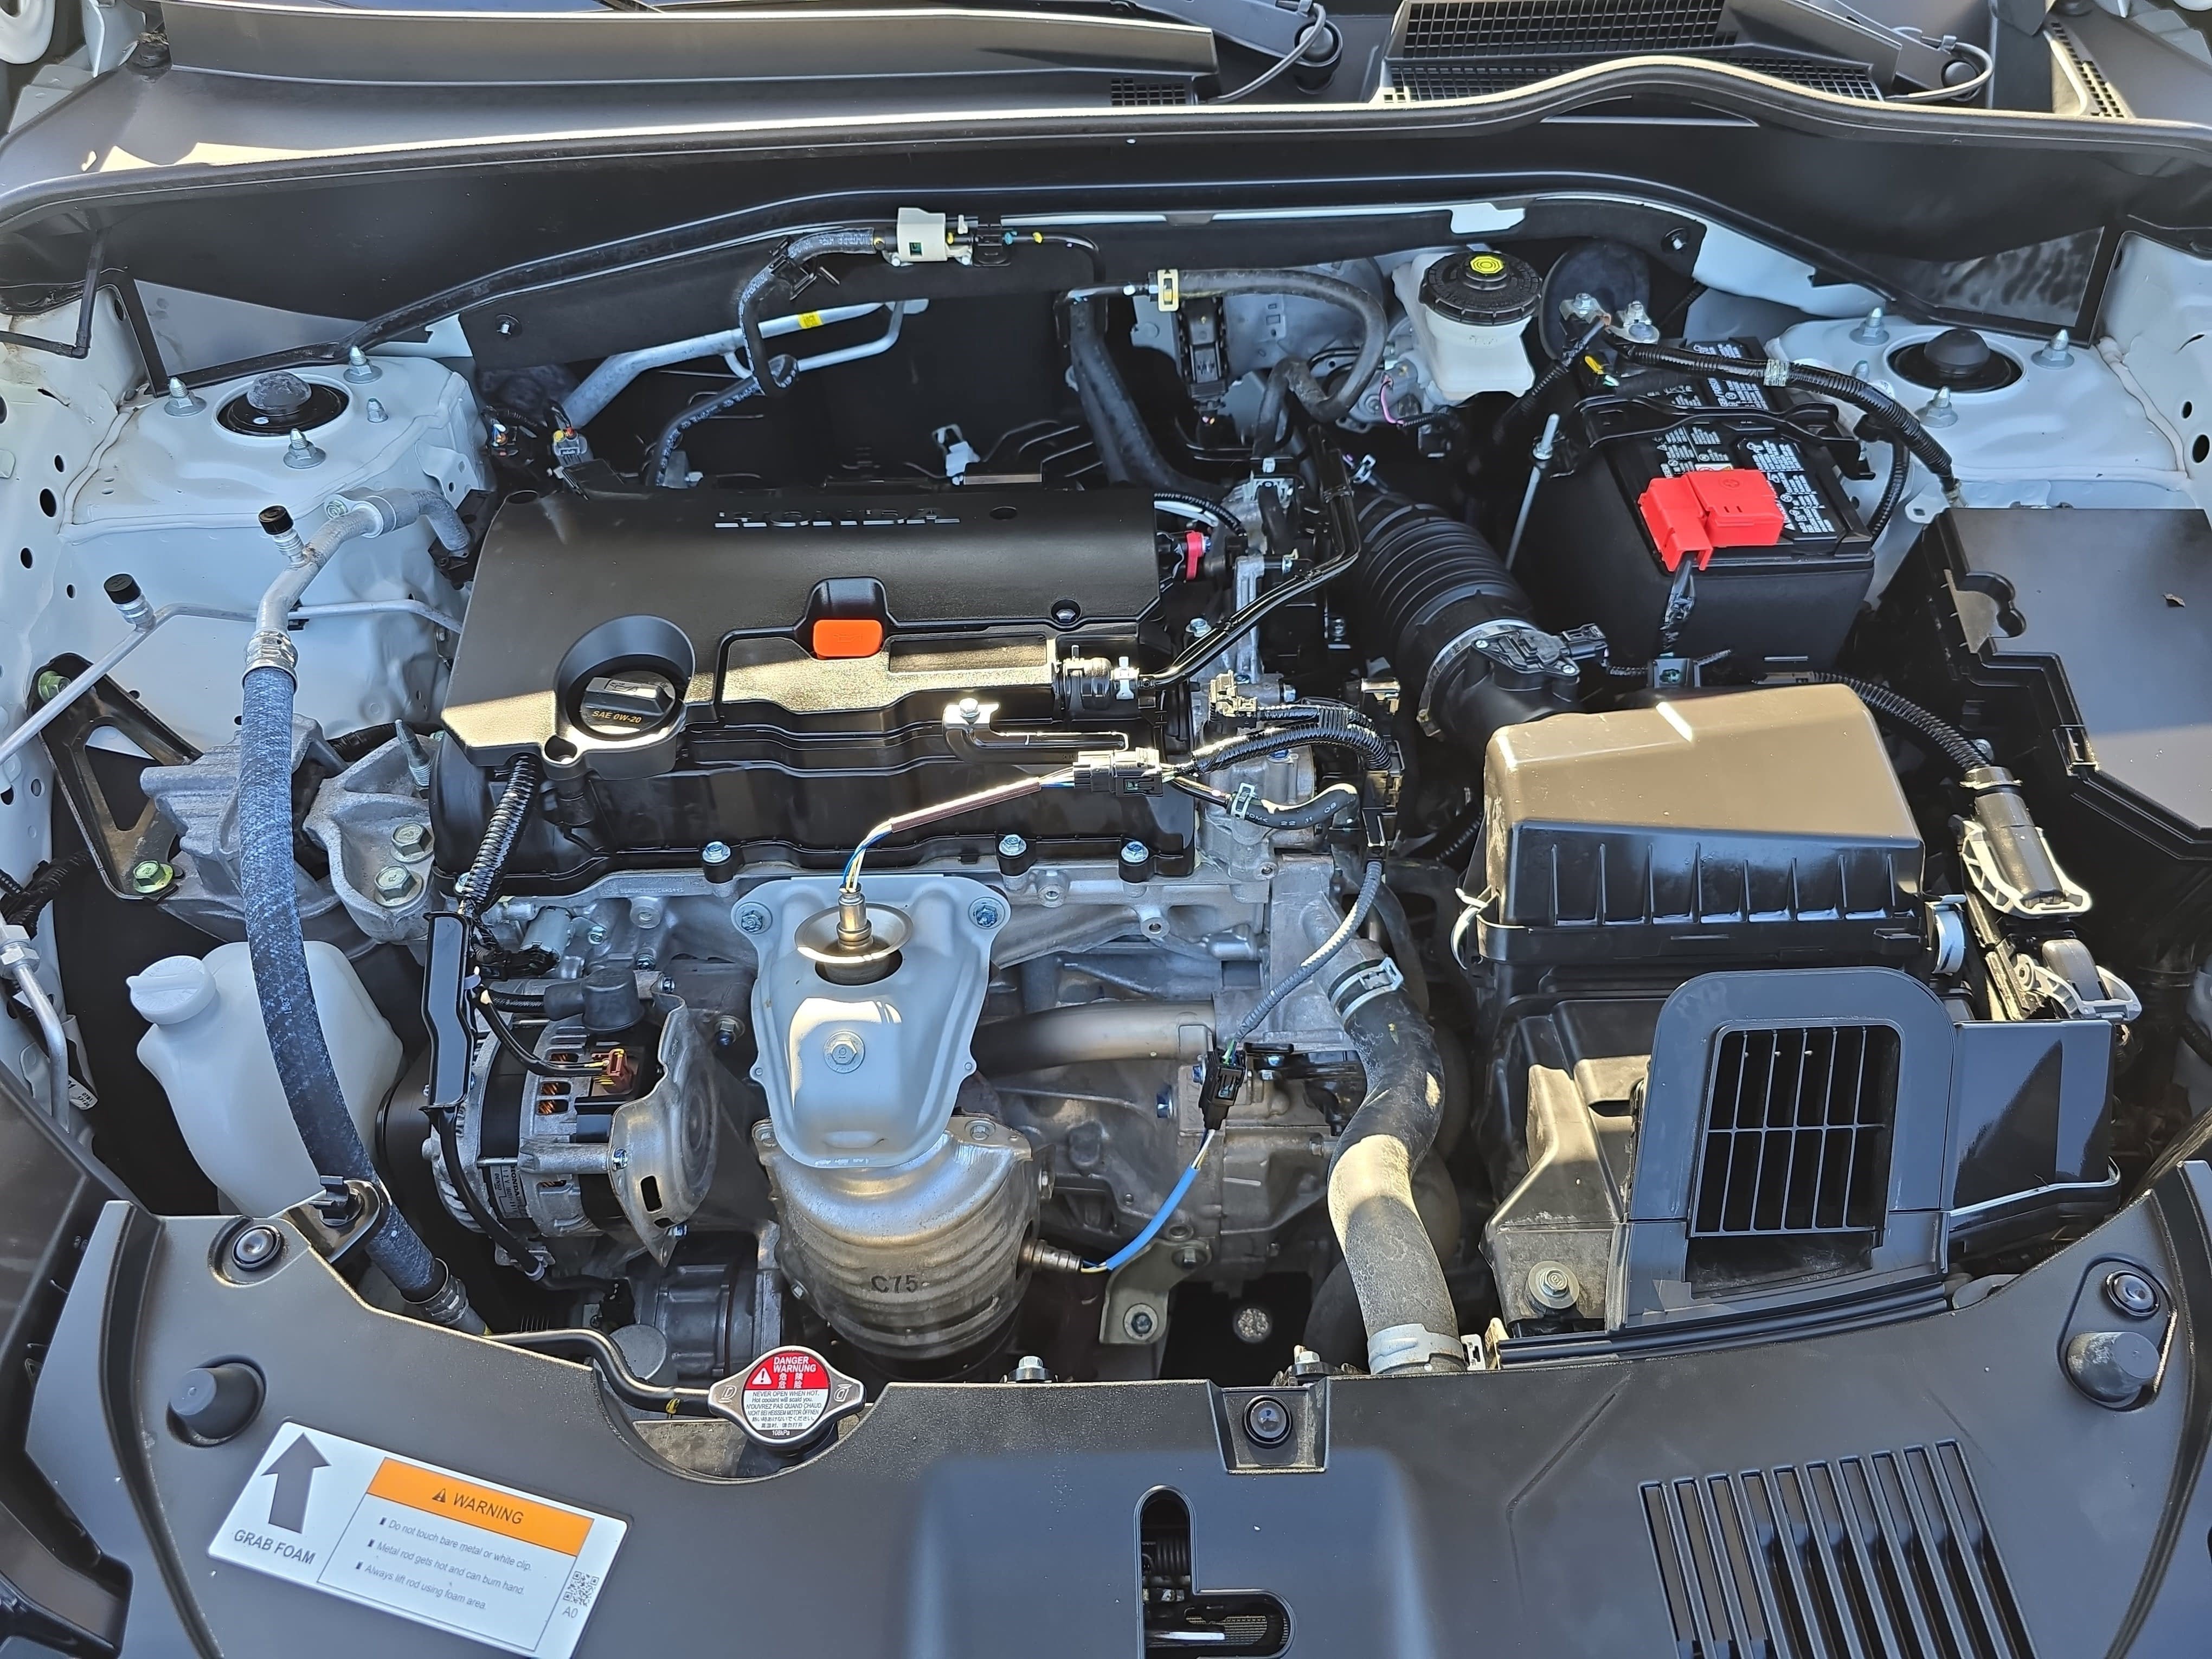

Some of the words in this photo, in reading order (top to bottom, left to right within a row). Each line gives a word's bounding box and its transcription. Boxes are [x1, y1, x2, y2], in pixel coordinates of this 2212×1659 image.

[592, 710, 613, 719] SAE
[613, 712, 642, 724] 0W-20
[510, 1165, 520, 1197] HONDA
[871, 1275, 919, 1294] C75
[773, 1364, 816, 1373] WARNUNG
[774, 1356, 809, 1365] DANGER
[453, 1492, 525, 1526] WARNING
[234, 1528, 275, 1552] GRAB
[274, 1541, 317, 1565] FOAM
[389, 1520, 401, 1531] Do
[402, 1525, 416, 1535] not
[417, 1528, 439, 1542] touch
[440, 1535, 458, 1548] bare
[460, 1542, 483, 1555] metal
[483, 1550, 493, 1559] or
[494, 1553, 516, 1566] white
[517, 1559, 532, 1572] clip.
[377, 1541, 400, 1555] Metal
[401, 1549, 414, 1560] rod
[415, 1554, 433, 1567] gets
[434, 1560, 448, 1571] hot
[449, 1564, 465, 1577] and
[466, 1570, 481, 1581] can
[482, 1574, 501, 1589] burn
[502, 1580, 525, 1595] hand.
[364, 1564, 394, 1580] Always
[395, 1572, 406, 1585] lift
[406, 1577, 420, 1589] rod
[421, 1584, 443, 1598] using
[444, 1589, 466, 1603] foam
[466, 1597, 487, 1610] area.
[562, 1606, 578, 1619] A0
